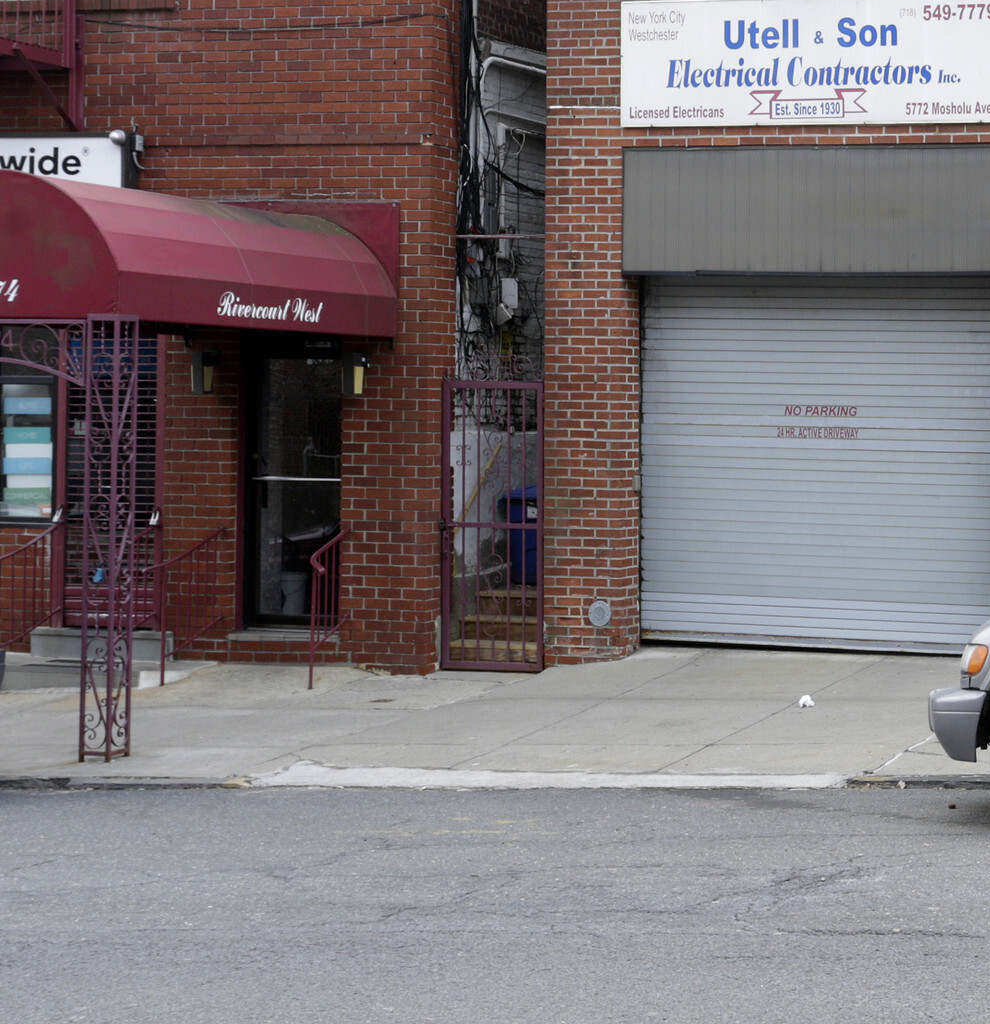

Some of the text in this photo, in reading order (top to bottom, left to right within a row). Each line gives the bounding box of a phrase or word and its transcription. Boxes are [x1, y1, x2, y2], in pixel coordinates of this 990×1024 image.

[628, 10, 686, 26] New York City
[899, 8, 916, 18] (718)
[629, 29, 679, 42] Westchester
[724, 17, 898, 50] Utell & Son
[666, 56, 961, 89] Electrical Contractors Inc.
[629, 106, 724, 119] Licensed Electricans
[775, 101, 841, 116] Est. Since 1930
[905, 102, 929, 115] 5772
[931, 101, 971, 115] Mosholu
[217, 291, 324, 323] Rivercourt West
[784, 405, 858, 417] NO PARKING
[777, 427, 784, 437] 24
[798, 427, 822, 439] ACTIVE
[823, 428, 859, 439] DRIVEWAY
